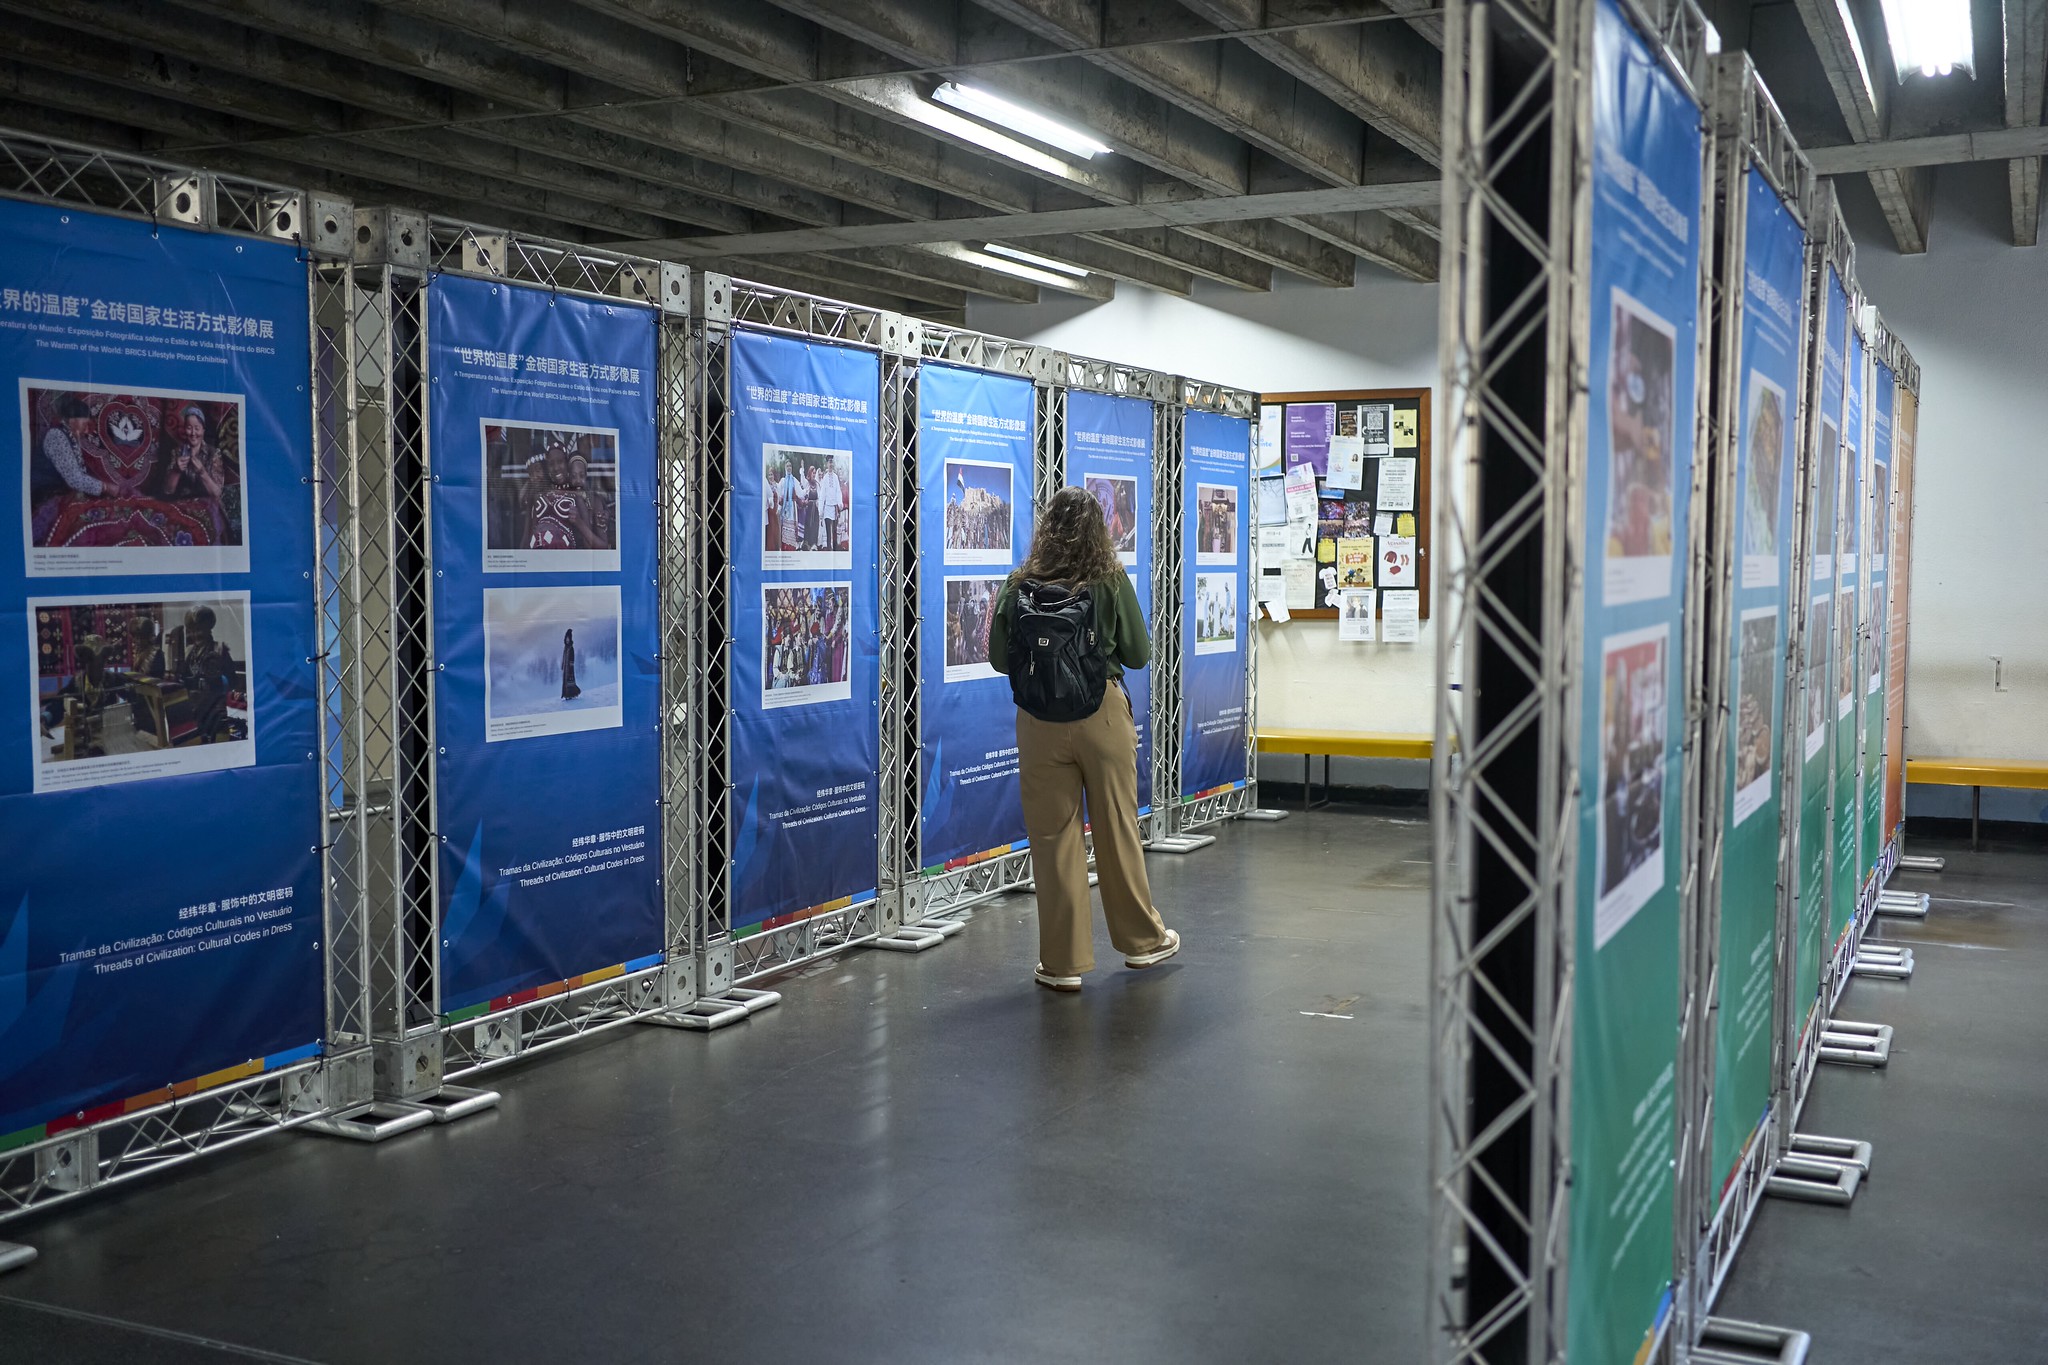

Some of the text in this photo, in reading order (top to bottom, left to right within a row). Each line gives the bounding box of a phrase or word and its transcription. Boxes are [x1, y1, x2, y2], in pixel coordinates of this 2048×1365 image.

[0, 288, 274, 340] 界的温度”金砖国家生活方式影像展
[39, 324, 66, 333] Mundo:
[68, 327, 104, 337] Exposição
[106, 331, 144, 341] Fotográfica
[171, 337, 188, 345] Estilo
[215, 342, 225, 350] nos
[50, 341, 78, 350] Warmth
[101, 346, 122, 354] World:
[125, 348, 146, 356] BRICS
[148, 350, 175, 360] Lifestyle
[177, 353, 195, 361] Photo
[197, 355, 228, 364] Exhibition
[454, 346, 640, 384] “世界的温度”金砖国家生活方式影像展
[459, 371, 487, 380] Temperatura
[499, 867, 522, 876] Tramas
[532, 857, 564, 870] Civilização:
[565, 853, 587, 863] Códigos
[589, 847, 612, 858] Culturais
[621, 841, 644, 851] Vestuário
[520, 876, 544, 887] Threads
[545, 874, 550, 882] of
[552, 869, 584, 880] Civilization:
[584, 862, 605, 873] Cultural
[606, 860, 623, 869] Codes
[179, 886, 293, 920] 经纬华章·服饰中的文明密码
[60, 906, 292, 962] Tramas da Civilização: Códigos Culturais no Vestuário
[94, 923, 292, 974] Threads of Civilization: Cultural Codes in Dress
